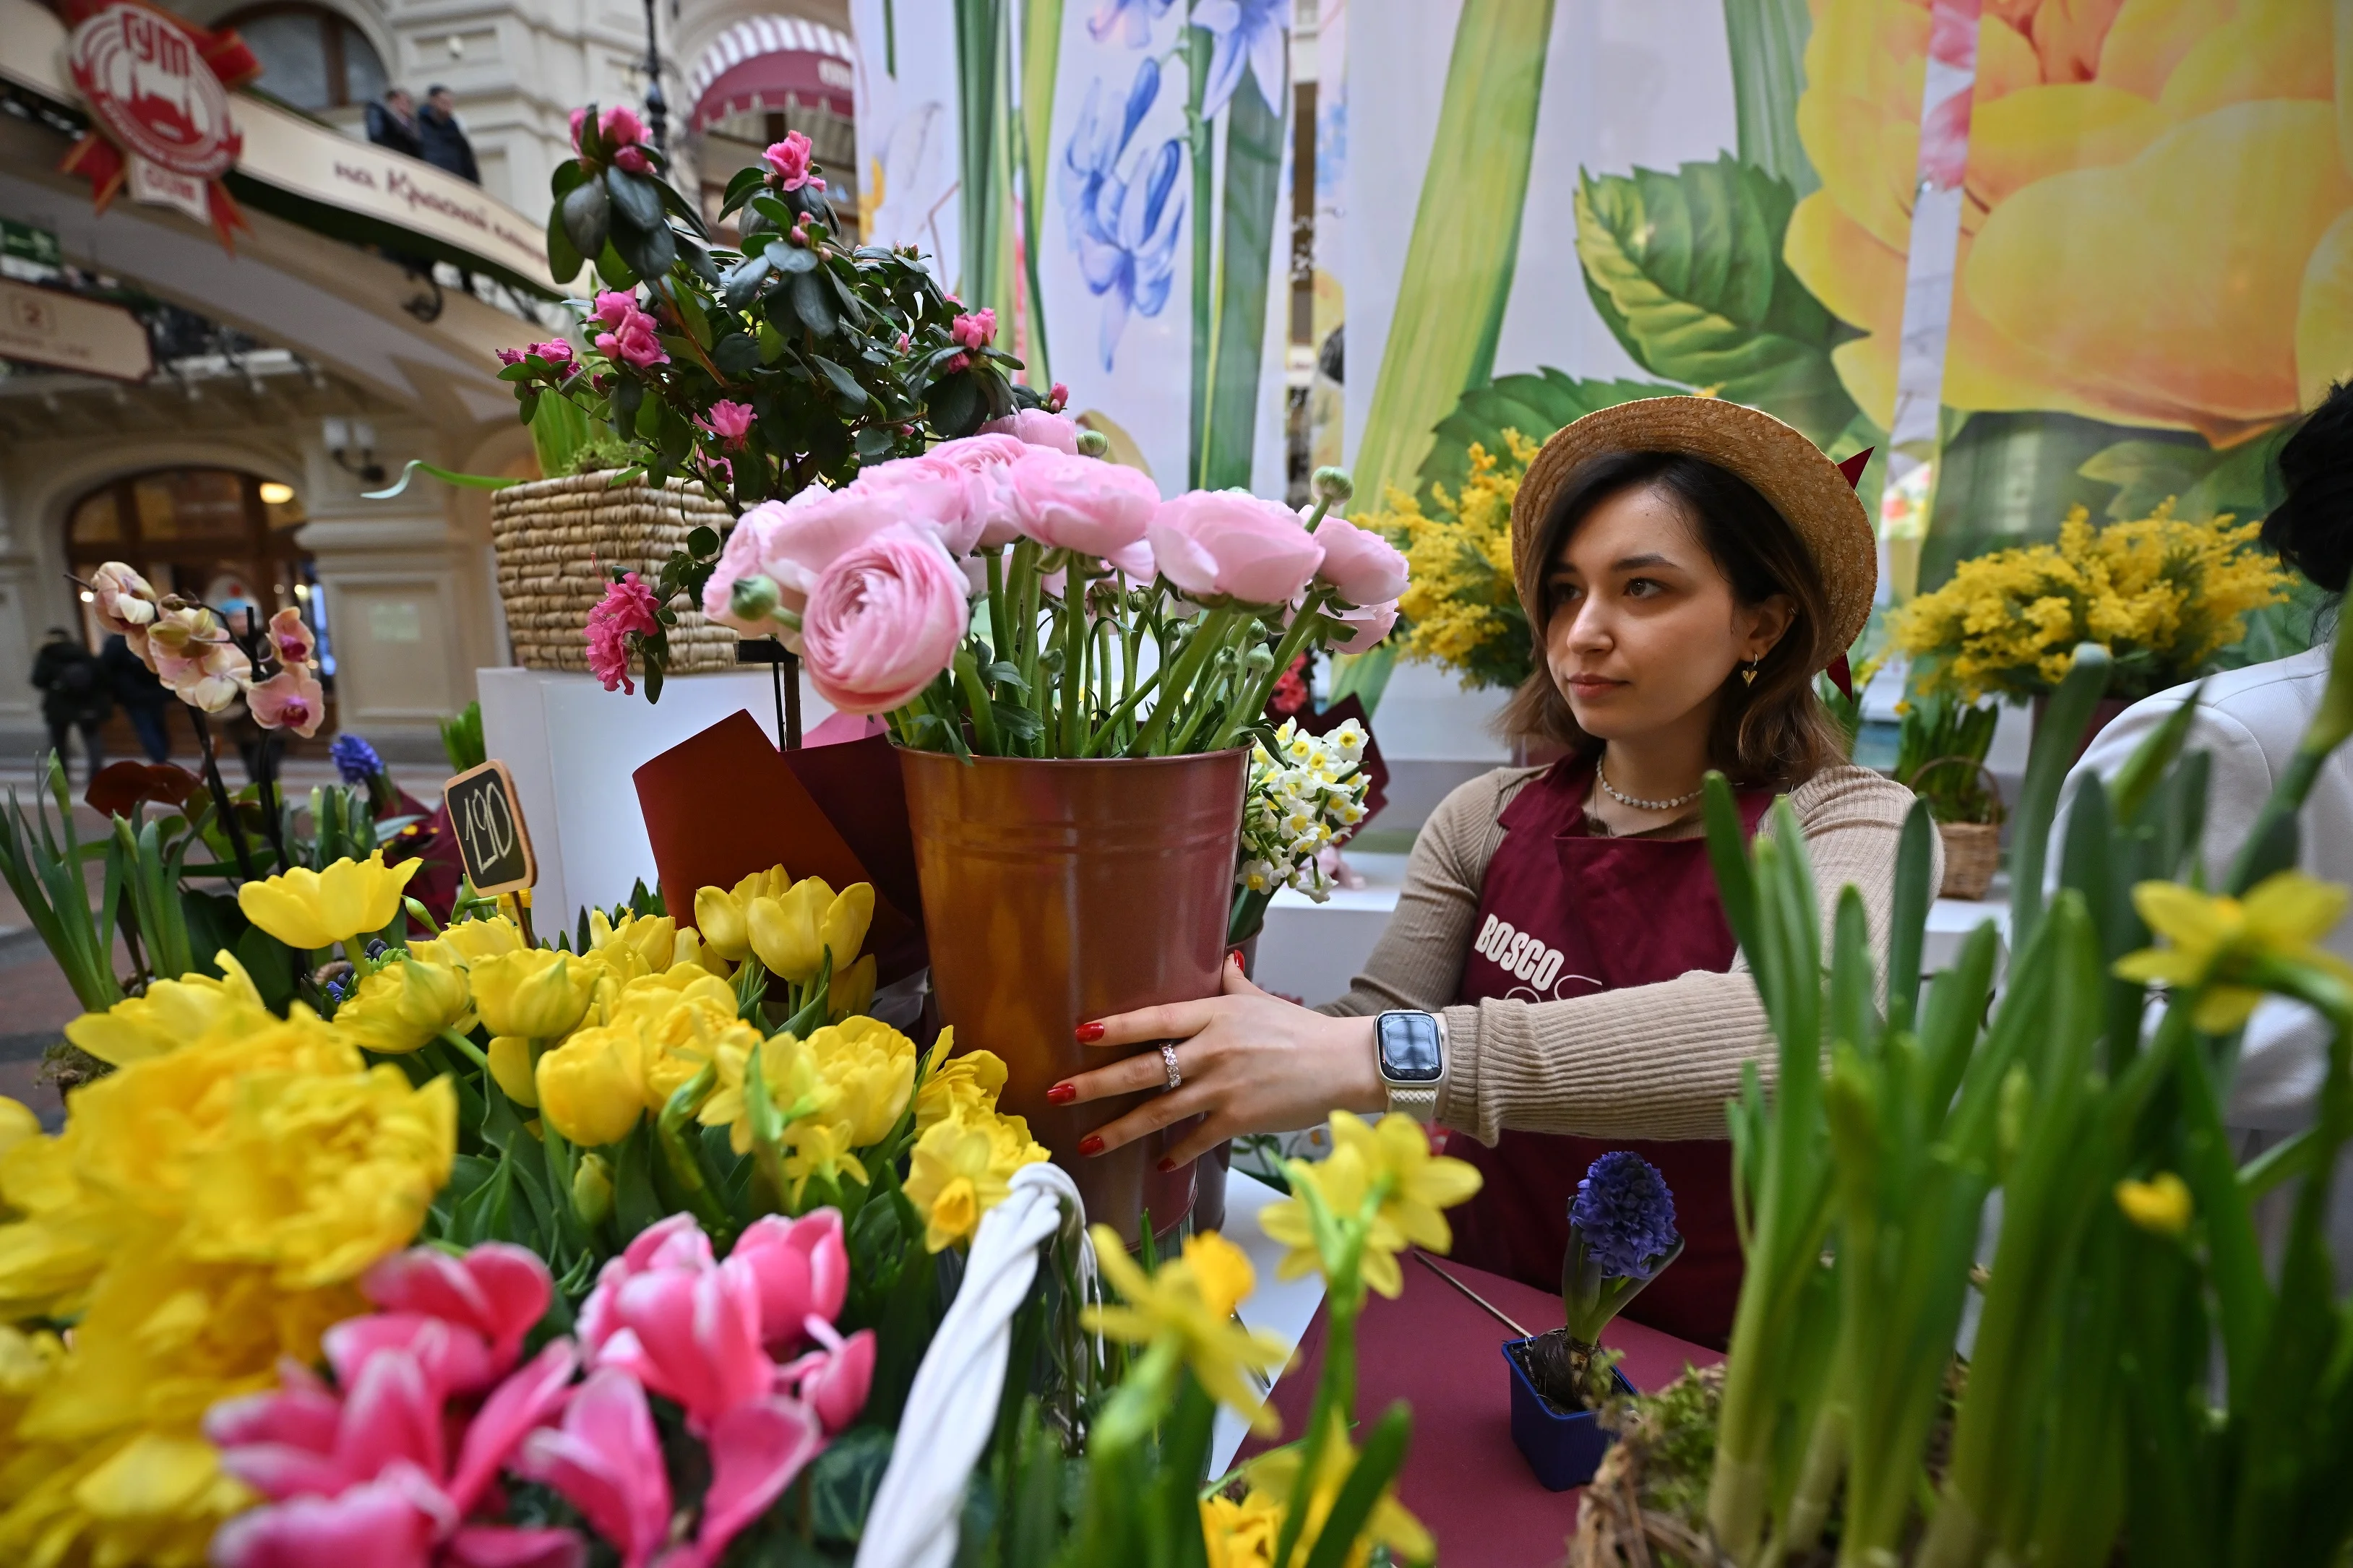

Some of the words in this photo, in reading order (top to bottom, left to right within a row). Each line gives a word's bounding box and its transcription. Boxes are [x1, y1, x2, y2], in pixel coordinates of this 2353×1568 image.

[335, 162, 377, 189] на
[464, 781, 513, 875] 190
[1474, 913, 1565, 991] BOSCO
